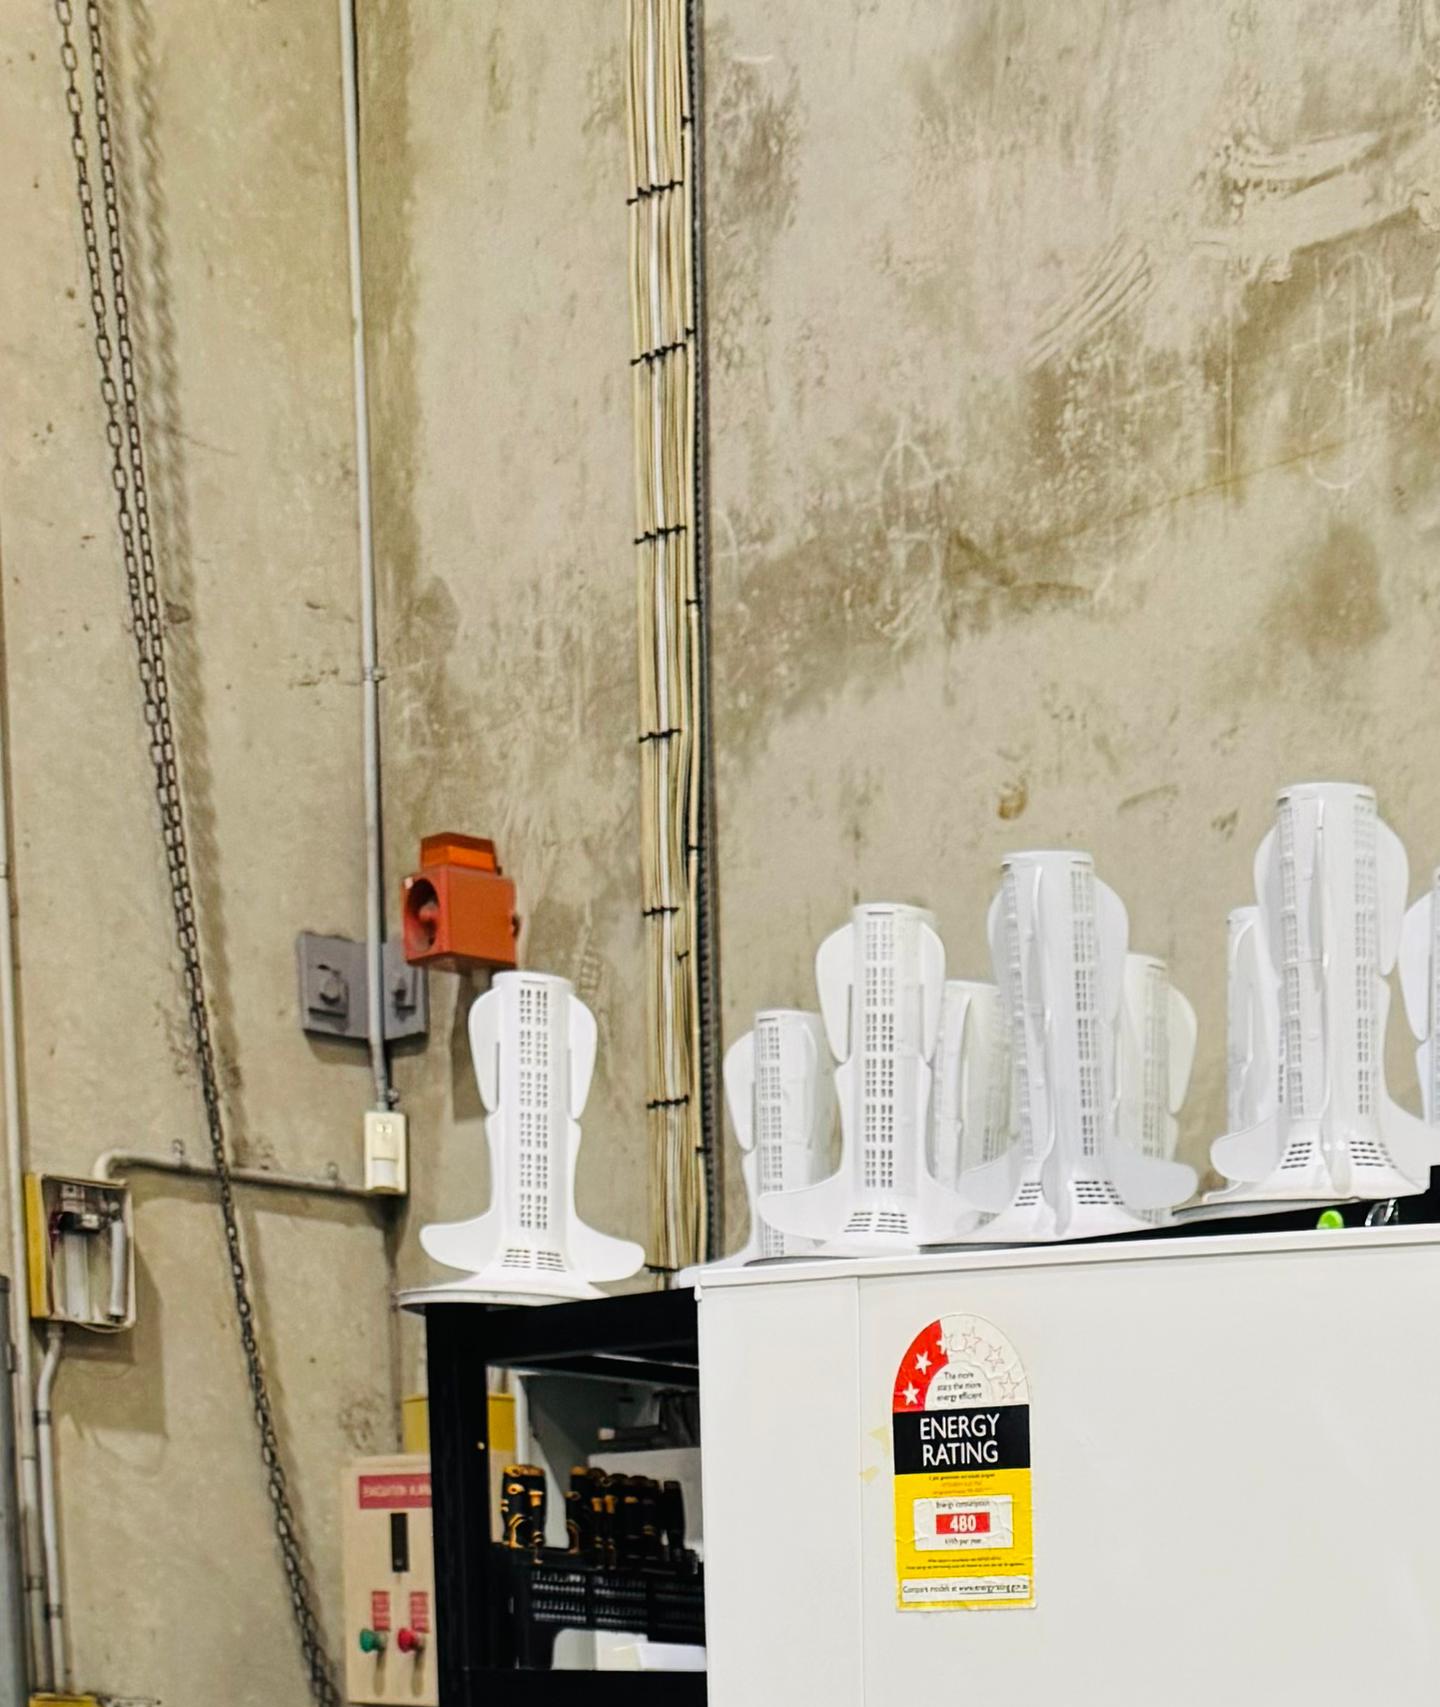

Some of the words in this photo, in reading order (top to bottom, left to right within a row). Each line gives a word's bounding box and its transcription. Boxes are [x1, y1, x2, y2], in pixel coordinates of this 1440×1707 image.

[920, 1413, 1000, 1440] ENERGY
[922, 1440, 998, 1467] RATING
[950, 1515, 976, 1532] 480
